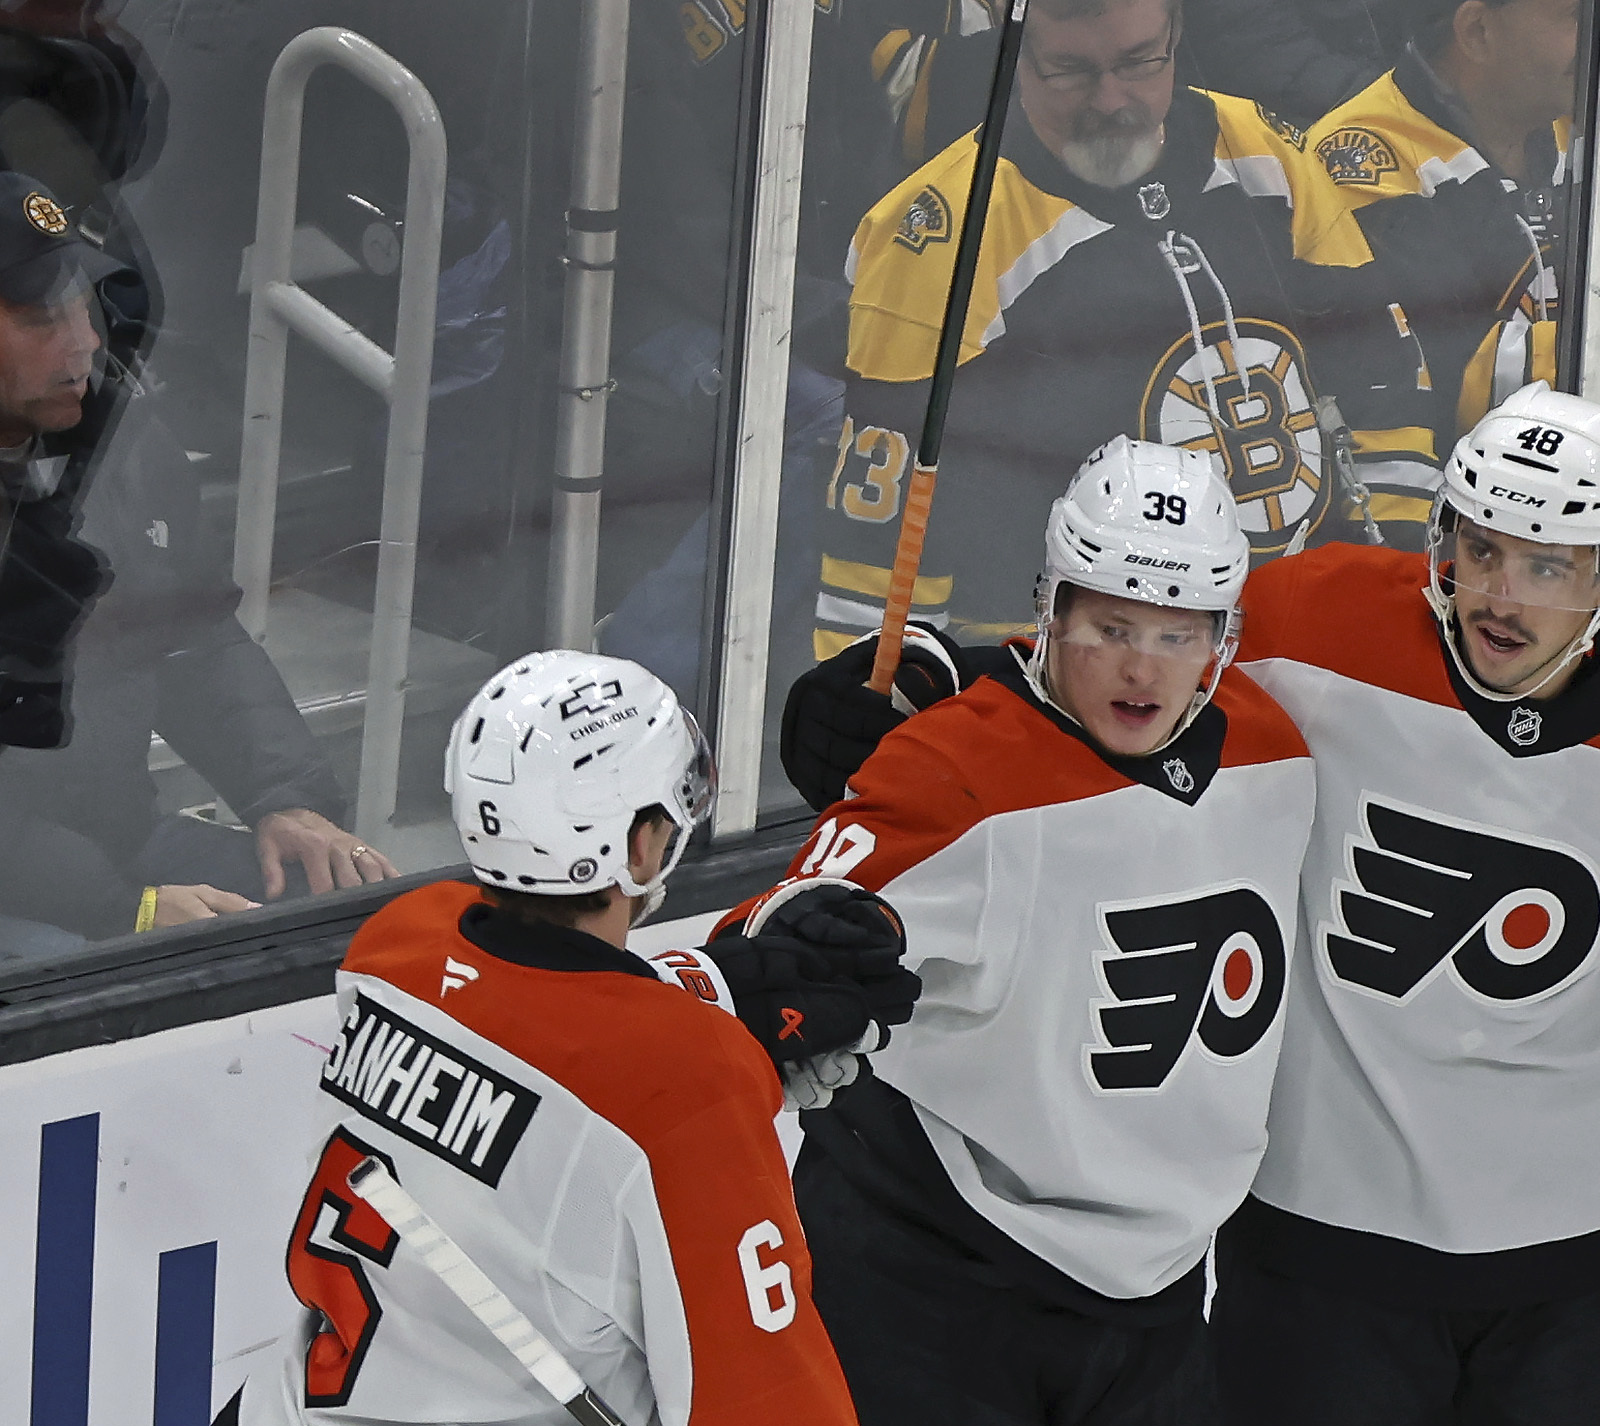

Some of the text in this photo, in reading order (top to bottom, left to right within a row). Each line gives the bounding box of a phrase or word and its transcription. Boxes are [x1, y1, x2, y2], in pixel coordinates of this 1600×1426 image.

[1317, 132, 1390, 167] RUINS
[1516, 425, 1564, 456] 48
[1143, 491, 1187, 526] 39
[1490, 485, 1547, 508] CCM
[1124, 554, 1191, 572] BAUER
[478, 800, 501, 836] 6
[324, 1003, 516, 1168] SANHEIM
[736, 1219, 798, 1334] 6
